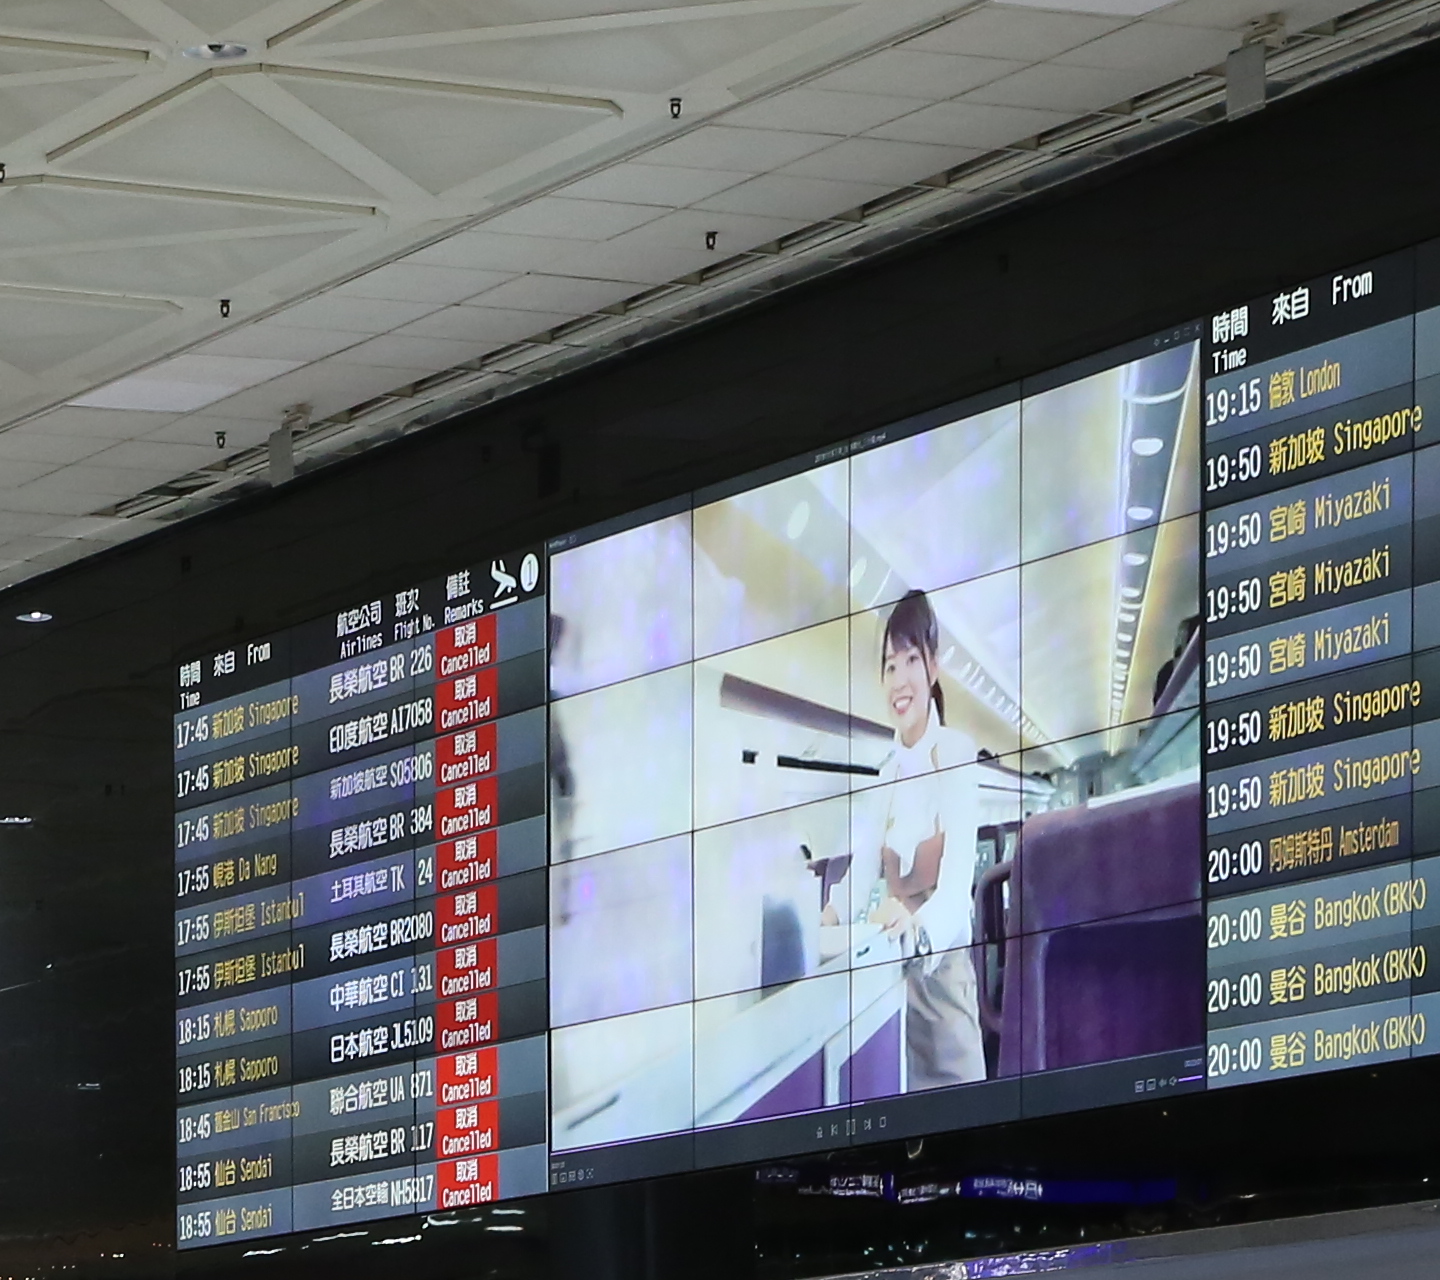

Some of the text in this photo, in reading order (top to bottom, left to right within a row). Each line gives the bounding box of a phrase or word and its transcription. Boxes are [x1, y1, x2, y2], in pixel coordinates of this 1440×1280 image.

[1212, 270, 1373, 344] 時間 來自 From
[1212, 347, 1247, 374] Time
[1206, 378, 1261, 427] 19:15
[1300, 360, 1341, 399] London
[1206, 445, 1261, 492] 19:50
[1269, 426, 1325, 476] 新加坡
[1334, 405, 1422, 455] Singapore
[1206, 577, 1261, 623] 19:50
[1269, 565, 1306, 609] 宮崎
[1314, 545, 1390, 596] Miyazaki
[247, 642, 271, 666] From
[340, 598, 484, 659] Airlines Remarks
[441, 642, 490, 676] Cancelled
[454, 622, 477, 648] 取消
[176, 645, 432, 750] 17:45 Singapore 長榮航空 BR 226
[1207, 710, 1261, 755] 19:50
[1269, 696, 1325, 742] 新加坡
[1334, 680, 1421, 726] Singapore
[1207, 776, 1261, 819] 19:50
[1269, 762, 1325, 807] 新加坡
[1334, 748, 1421, 792] Singapore
[177, 851, 277, 898] 17:55 Da Nang
[330, 1020, 388, 1064] 日本航空
